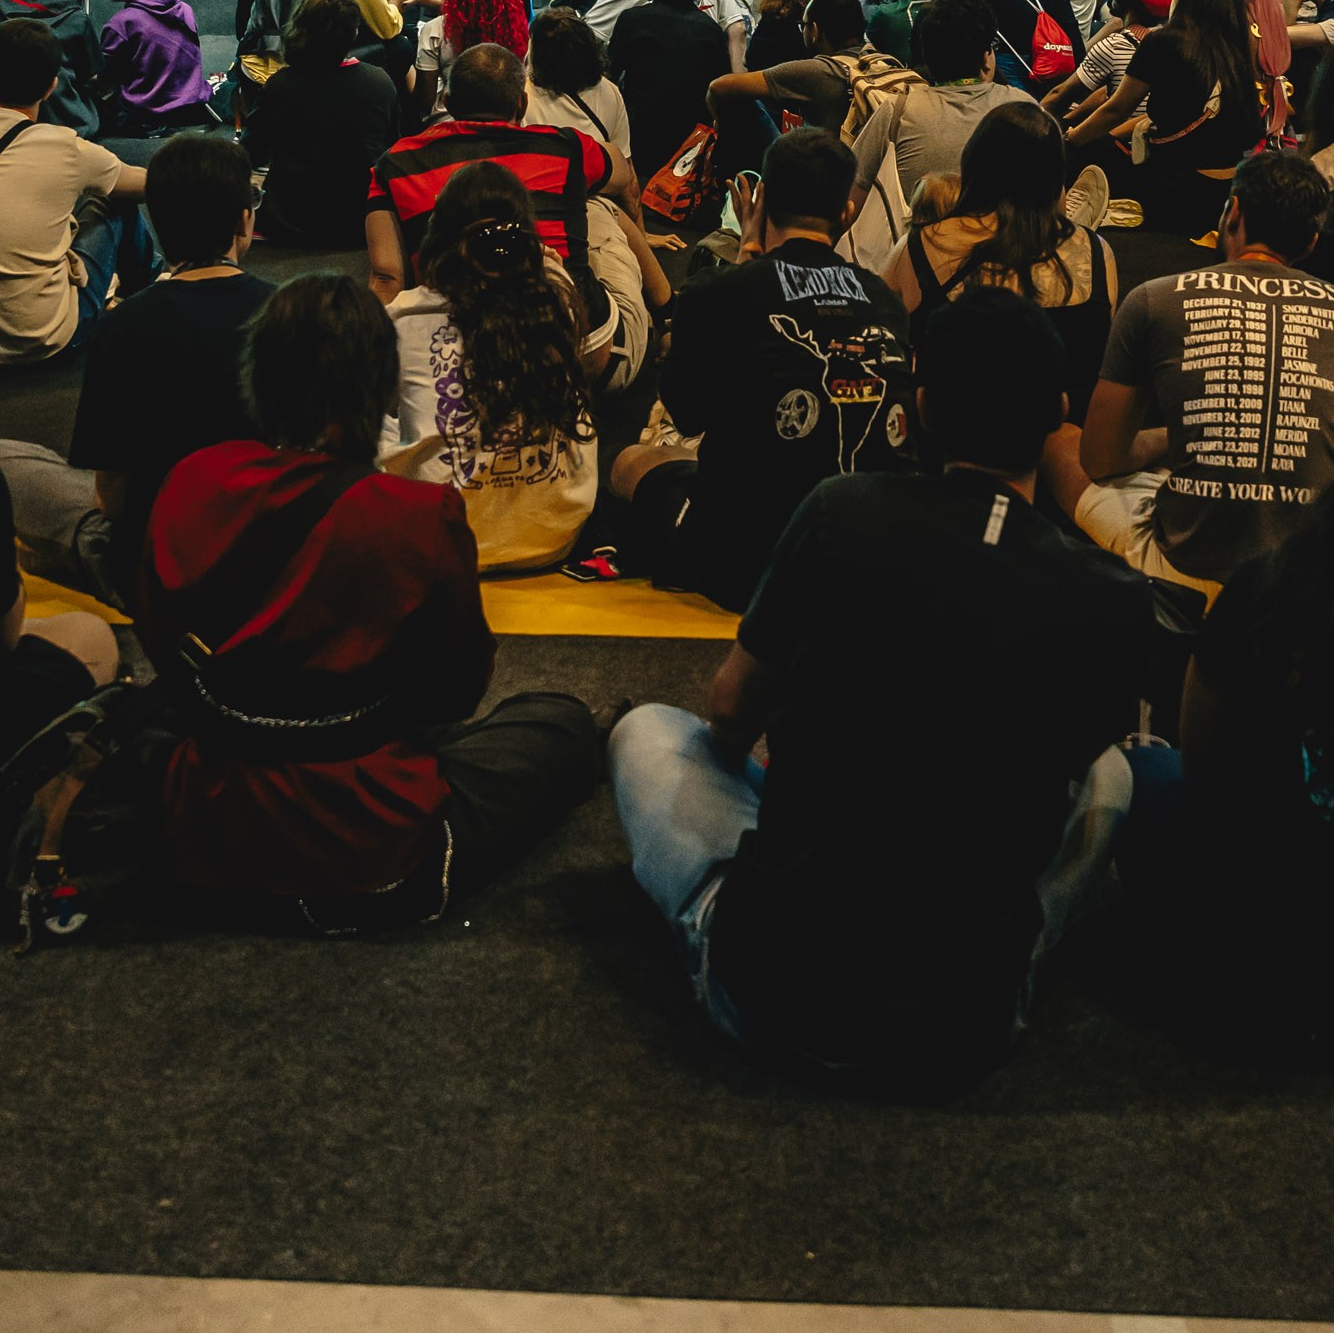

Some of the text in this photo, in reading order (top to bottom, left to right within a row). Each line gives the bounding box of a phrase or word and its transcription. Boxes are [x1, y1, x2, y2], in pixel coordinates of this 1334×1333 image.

[774, 259, 872, 305] KENDRICK
[1183, 297, 1231, 310] DECEMBER
[1282, 304, 1309, 315] SNOW
[1185, 308, 1231, 321] FEBRUARY
[1190, 319, 1228, 332] JANUARY
[1282, 314, 1334, 331] CINDERELLA
[1183, 330, 1230, 346] NOVEMBER
[1282, 324, 1320, 339] AURORA
[1282, 335, 1308, 348] ARIEL
[1183, 343, 1229, 359] NOVEMBER
[1245, 344, 1266, 355] 1991
[1281, 347, 1308, 360] BELLE
[1181, 357, 1226, 372] NOVEMBER
[1243, 357, 1265, 368] 1992
[1281, 359, 1318, 375] JASMINE
[1204, 369, 1226, 381] JUNE
[1243, 370, 1265, 381] 1995
[1204, 383, 1226, 395] JUNE
[1279, 385, 1312, 400] MULAN
[1183, 398, 1226, 412] DECEMBER
[1239, 398, 1263, 410] 2009
[1278, 399, 1306, 414] TIANA
[1240, 412, 1262, 425] 2010
[1276, 414, 1321, 431] RAPUNZEL
[1203, 427, 1223, 438] JUNE
[1239, 427, 1260, 439] 2012
[1275, 428, 1308, 444] MERIDA
[1273, 442, 1307, 458] MOANA
[1196, 454, 1226, 467] MARCH
[1236, 456, 1258, 468] 2021
[1271, 457, 1294, 472] RAYA
[1167, 475, 1315, 505] CREATE YOUR WO
